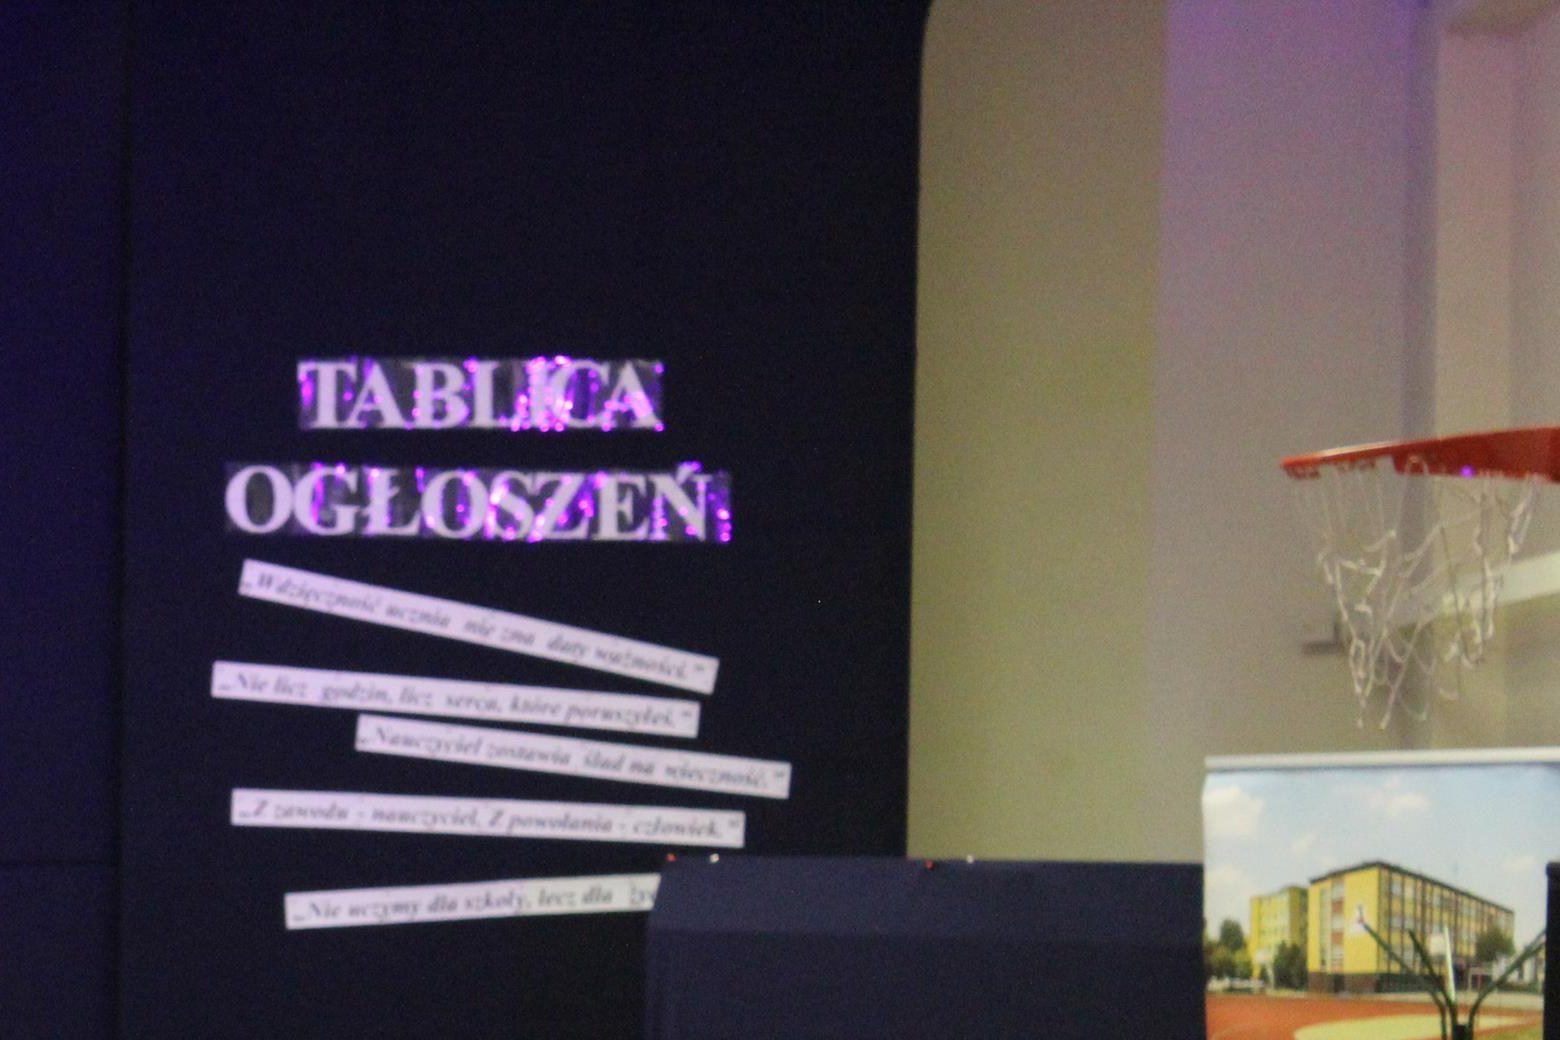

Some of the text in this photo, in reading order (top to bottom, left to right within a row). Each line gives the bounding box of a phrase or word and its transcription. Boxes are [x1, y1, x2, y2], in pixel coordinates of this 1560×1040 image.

[300, 359, 662, 430] TABLICA
[225, 463, 712, 541] OGŁOSZEŃ
[385, 602, 451, 629] ucznia
[463, 616, 495, 637] nie
[500, 626, 535, 646] zna
[547, 633, 587, 660] daty
[273, 675, 307, 698] licz
[398, 686, 433, 707] licz
[487, 742, 571, 764] zostawia
[582, 749, 627, 772] ślad
[629, 761, 655, 775] na
[273, 801, 350, 821] zawodu
[487, 808, 504, 828] Z
[427, 893, 459, 914] dla
[538, 887, 578, 907] lecz
[581, 884, 613, 905] dla
